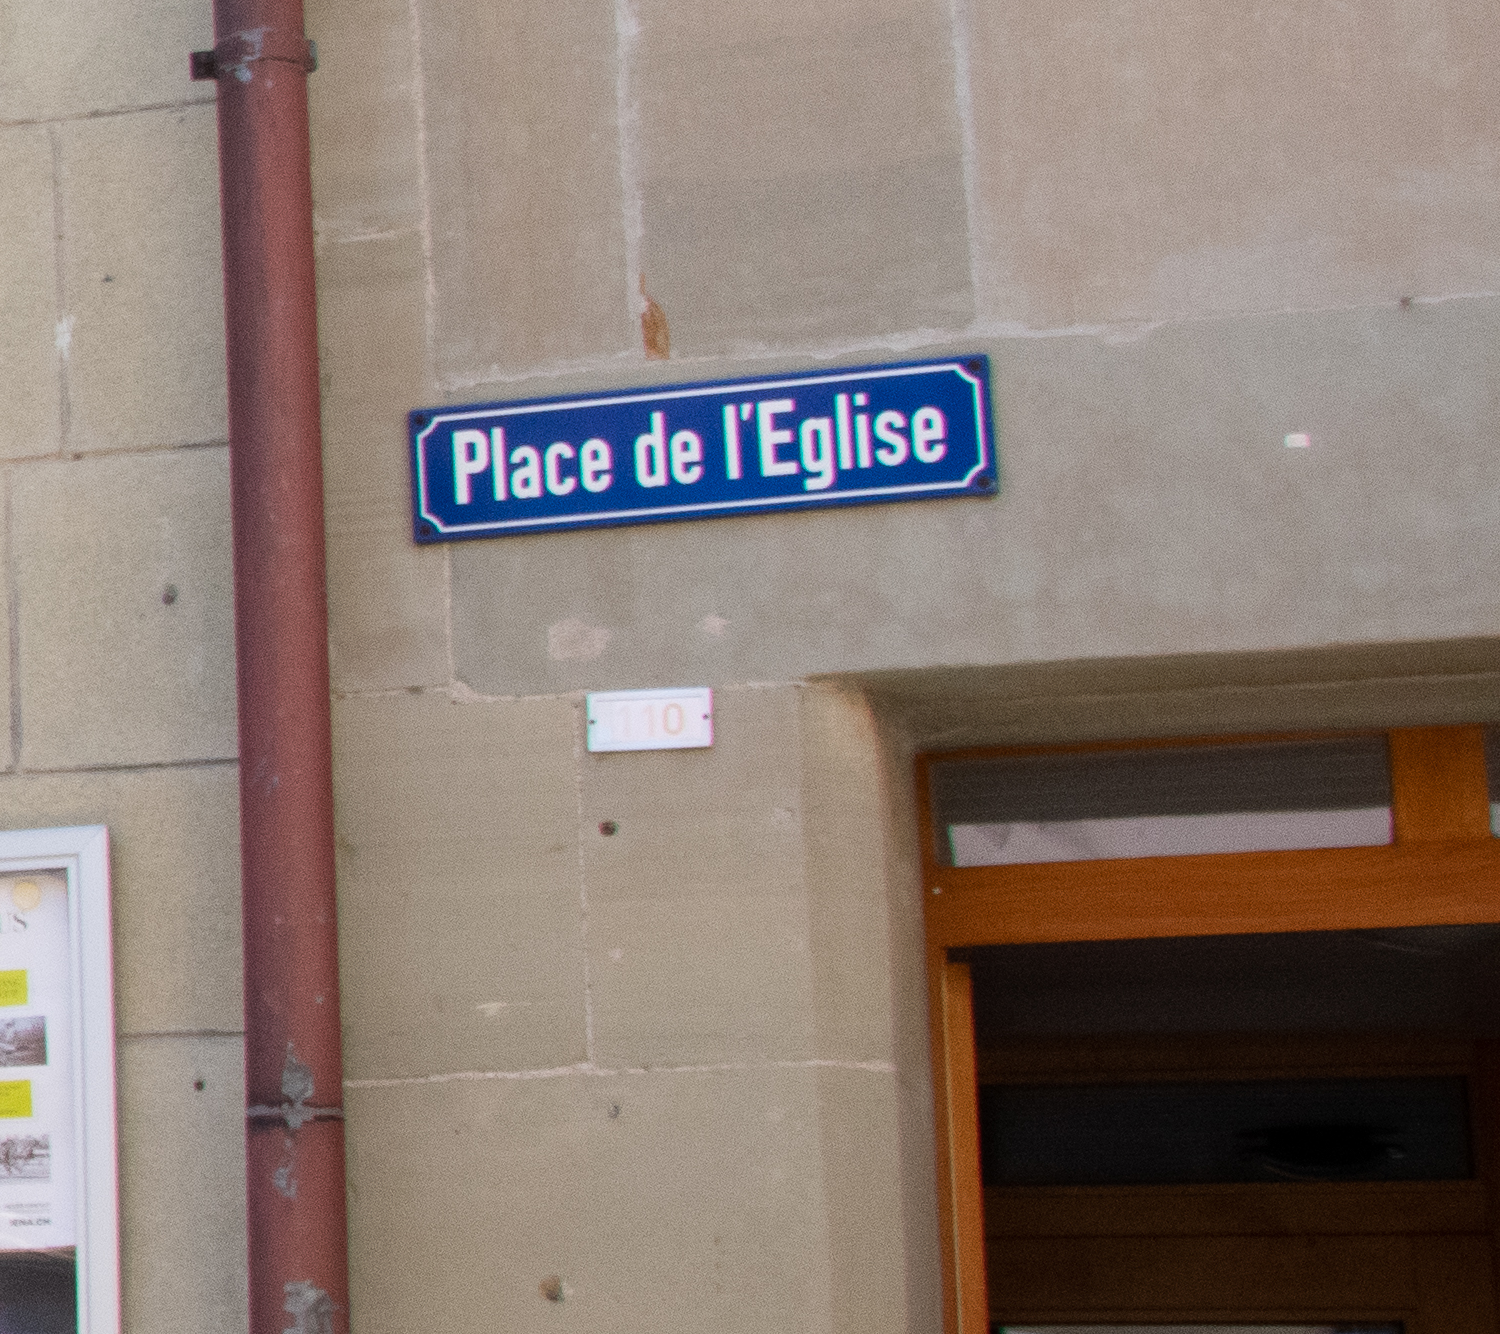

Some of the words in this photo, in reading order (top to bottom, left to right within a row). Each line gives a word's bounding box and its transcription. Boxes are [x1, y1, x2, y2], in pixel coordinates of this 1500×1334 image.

[451, 427, 613, 505] Place
[634, 412, 703, 488] de
[722, 393, 948, 492] l'Eglise
